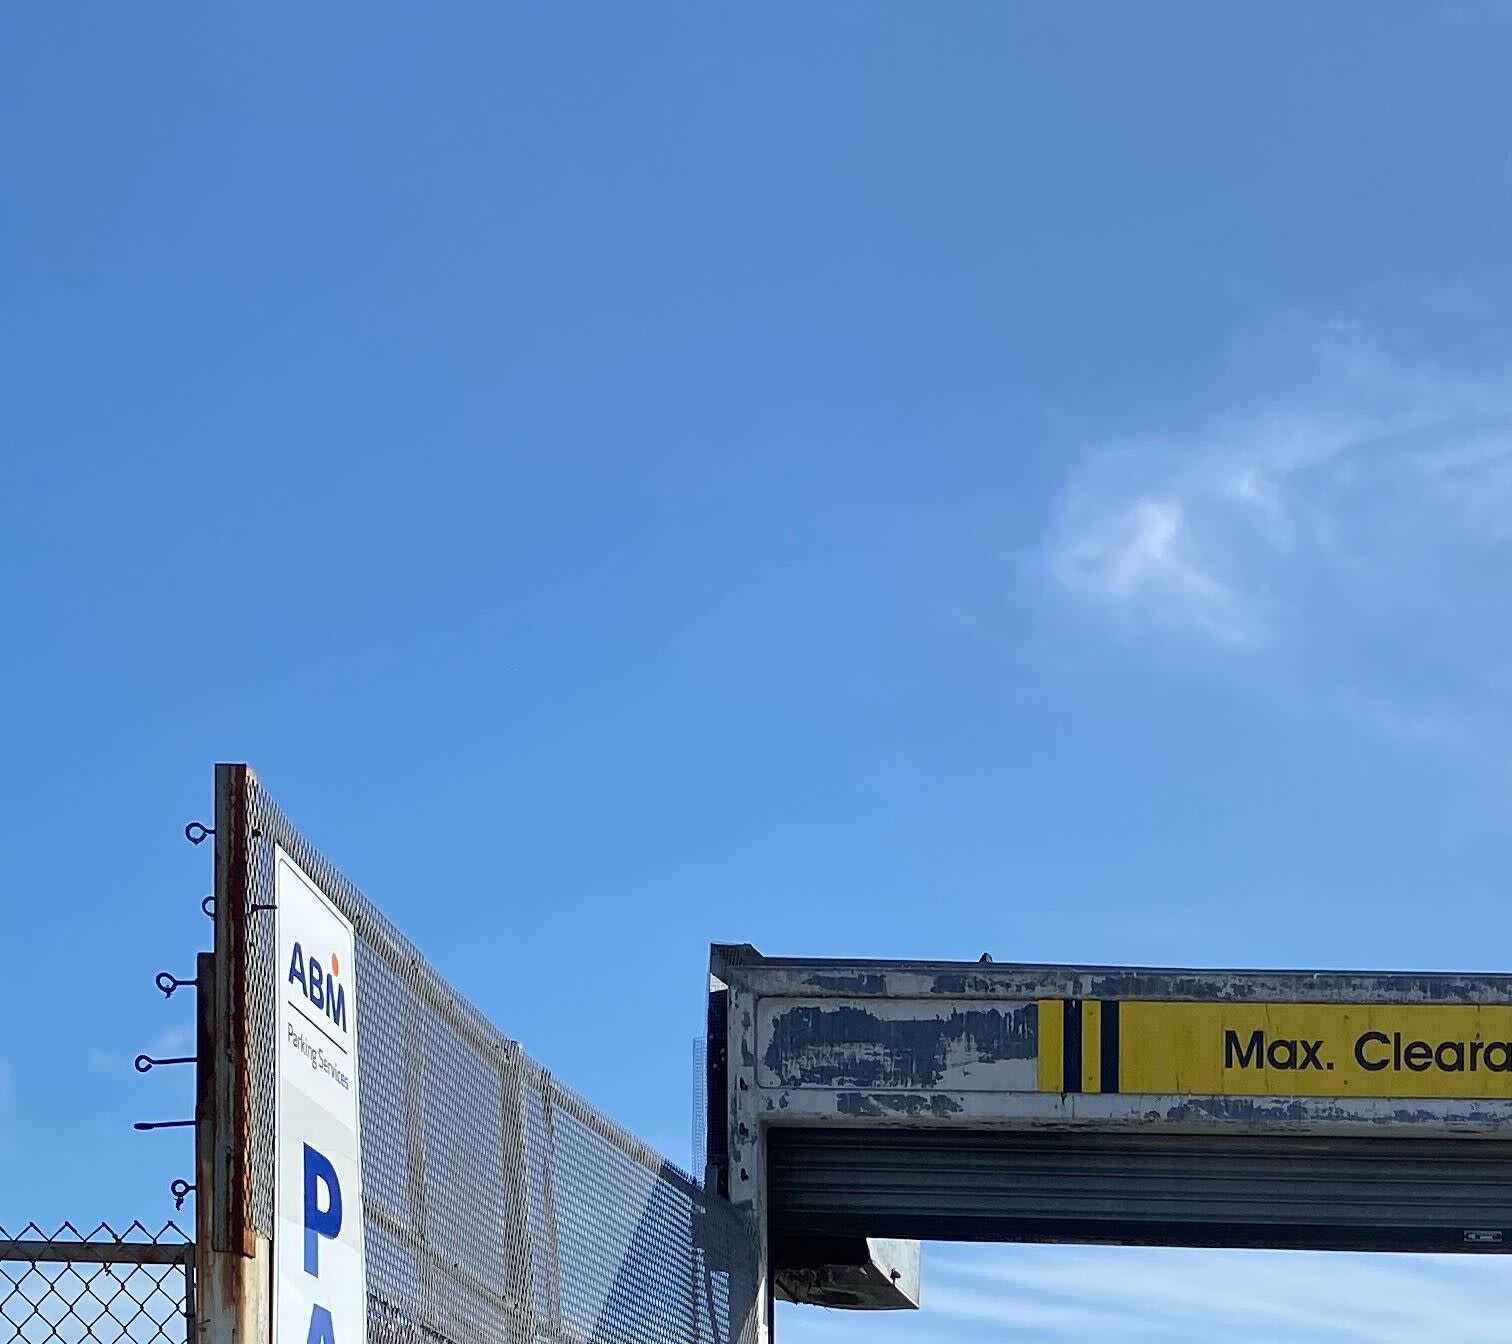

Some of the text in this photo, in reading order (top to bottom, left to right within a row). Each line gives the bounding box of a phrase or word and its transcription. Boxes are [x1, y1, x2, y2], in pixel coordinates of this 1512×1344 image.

[288, 942, 347, 1033] ABM
[287, 1021, 350, 1091] Parking Services
[1224, 1030, 1334, 1071] Max.
